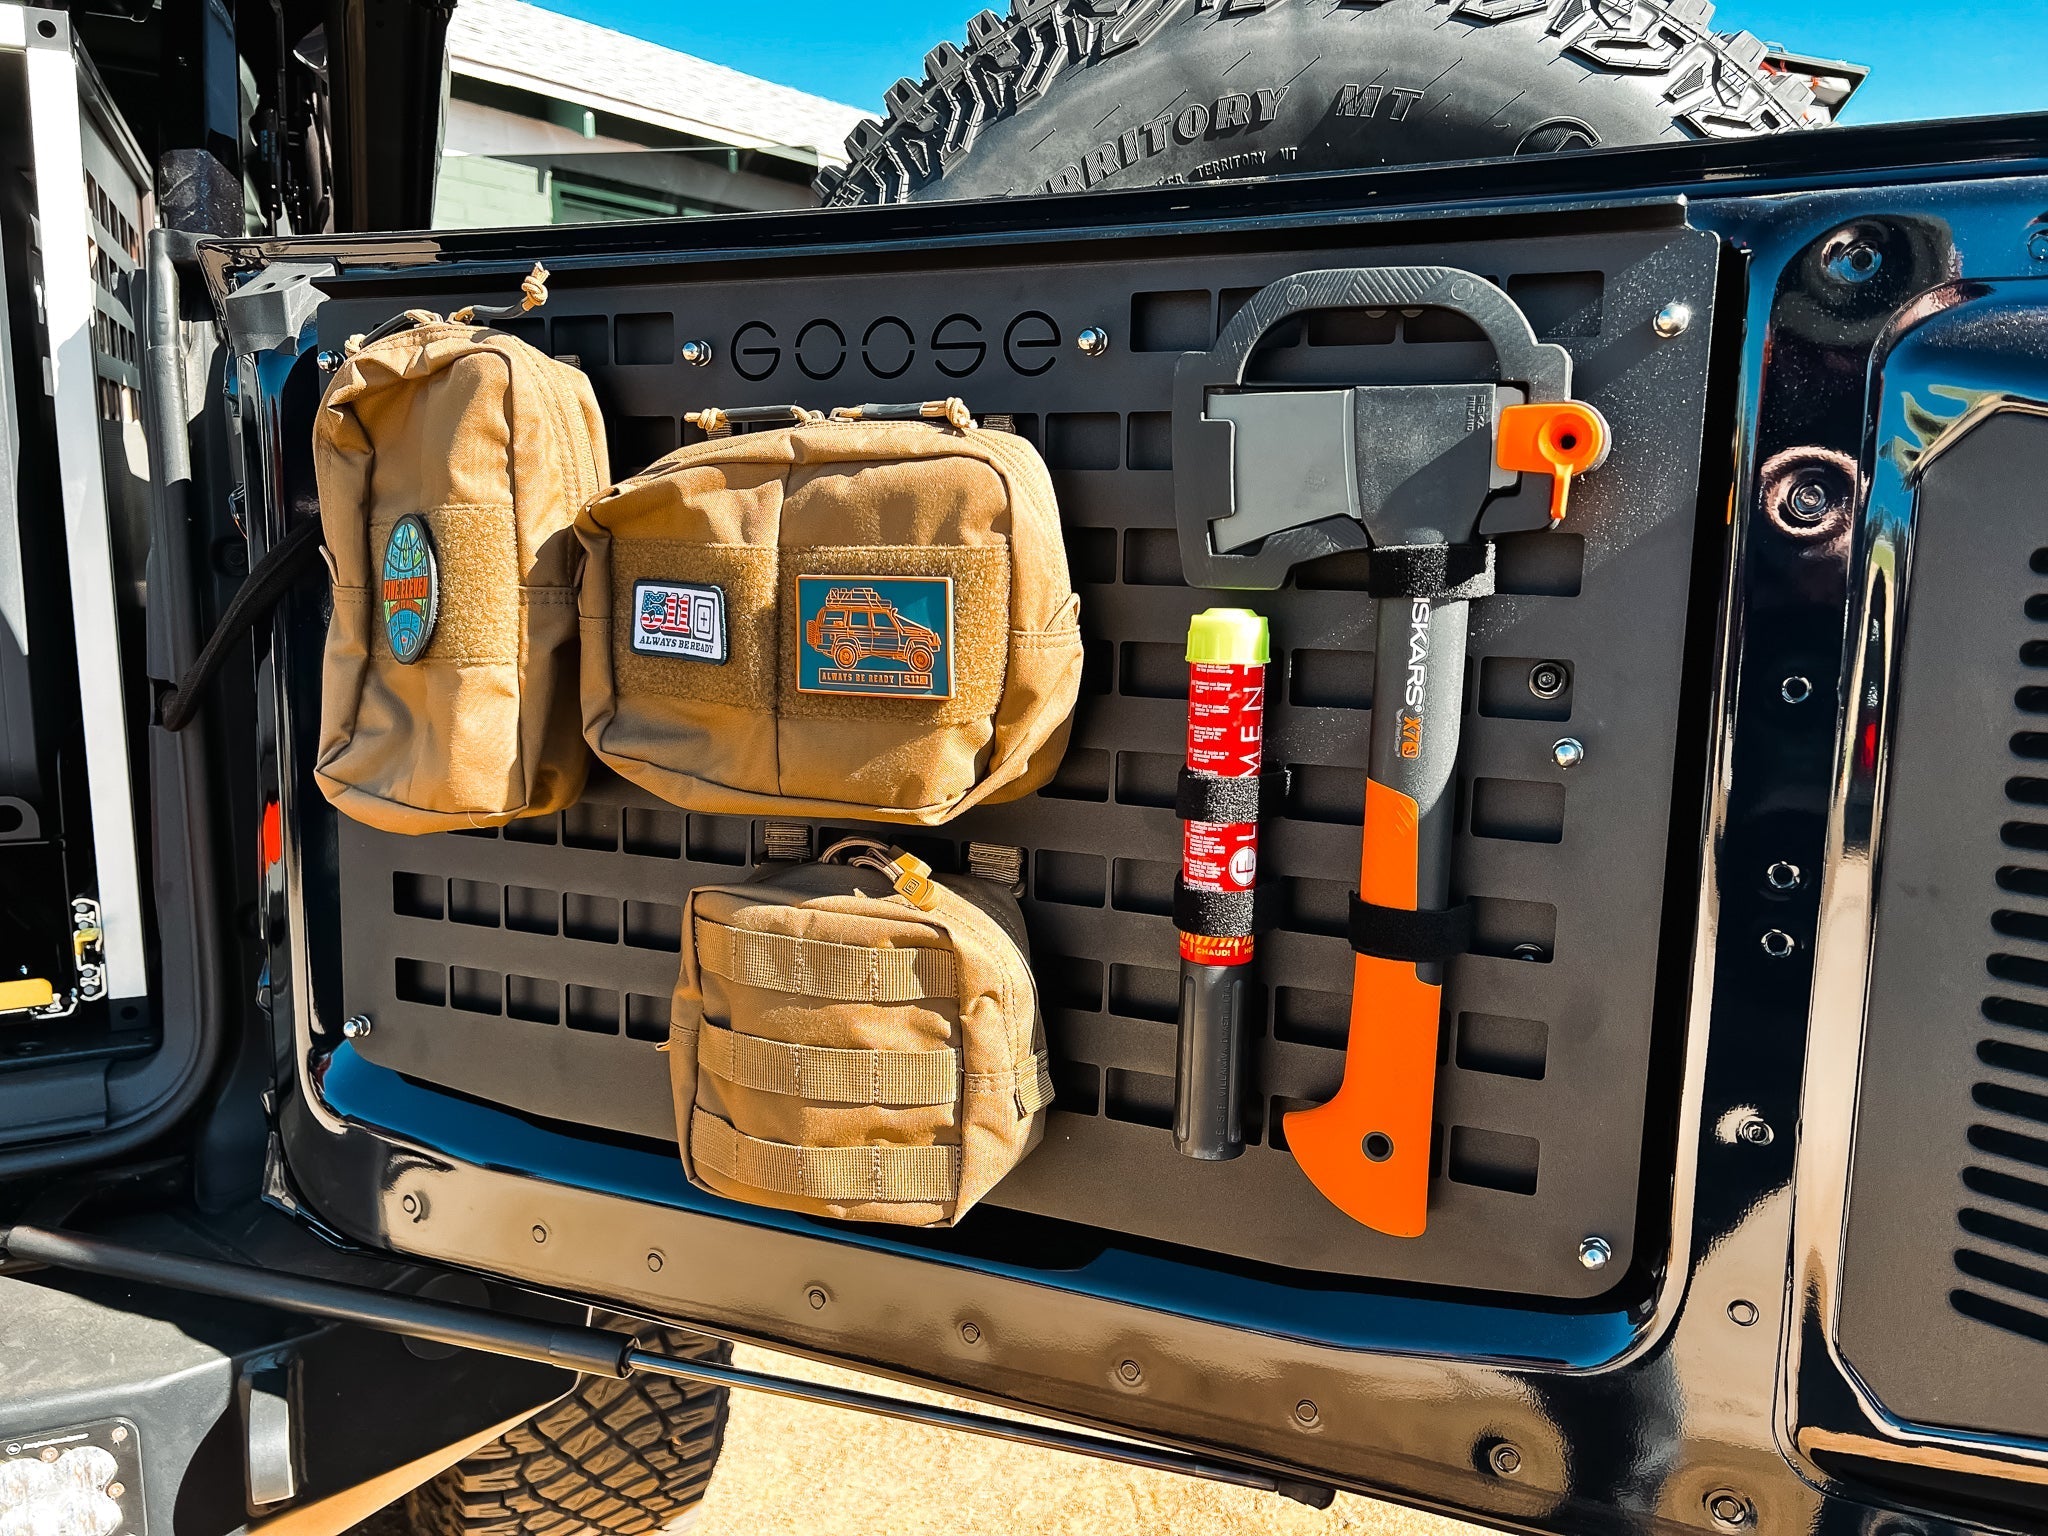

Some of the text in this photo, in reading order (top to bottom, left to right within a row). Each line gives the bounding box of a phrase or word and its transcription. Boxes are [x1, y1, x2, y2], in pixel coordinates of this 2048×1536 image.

[1032, 82, 1425, 194] RRITORY MT
[1196, 150, 1266, 178] TERRITORY
[640, 636, 714, 654] ALWAYS BE READY
[1405, 597, 1431, 708] ISKARS
[822, 672, 894, 684] ALWAYS BE READY
[1196, 947, 1231, 957] CHAUD!
